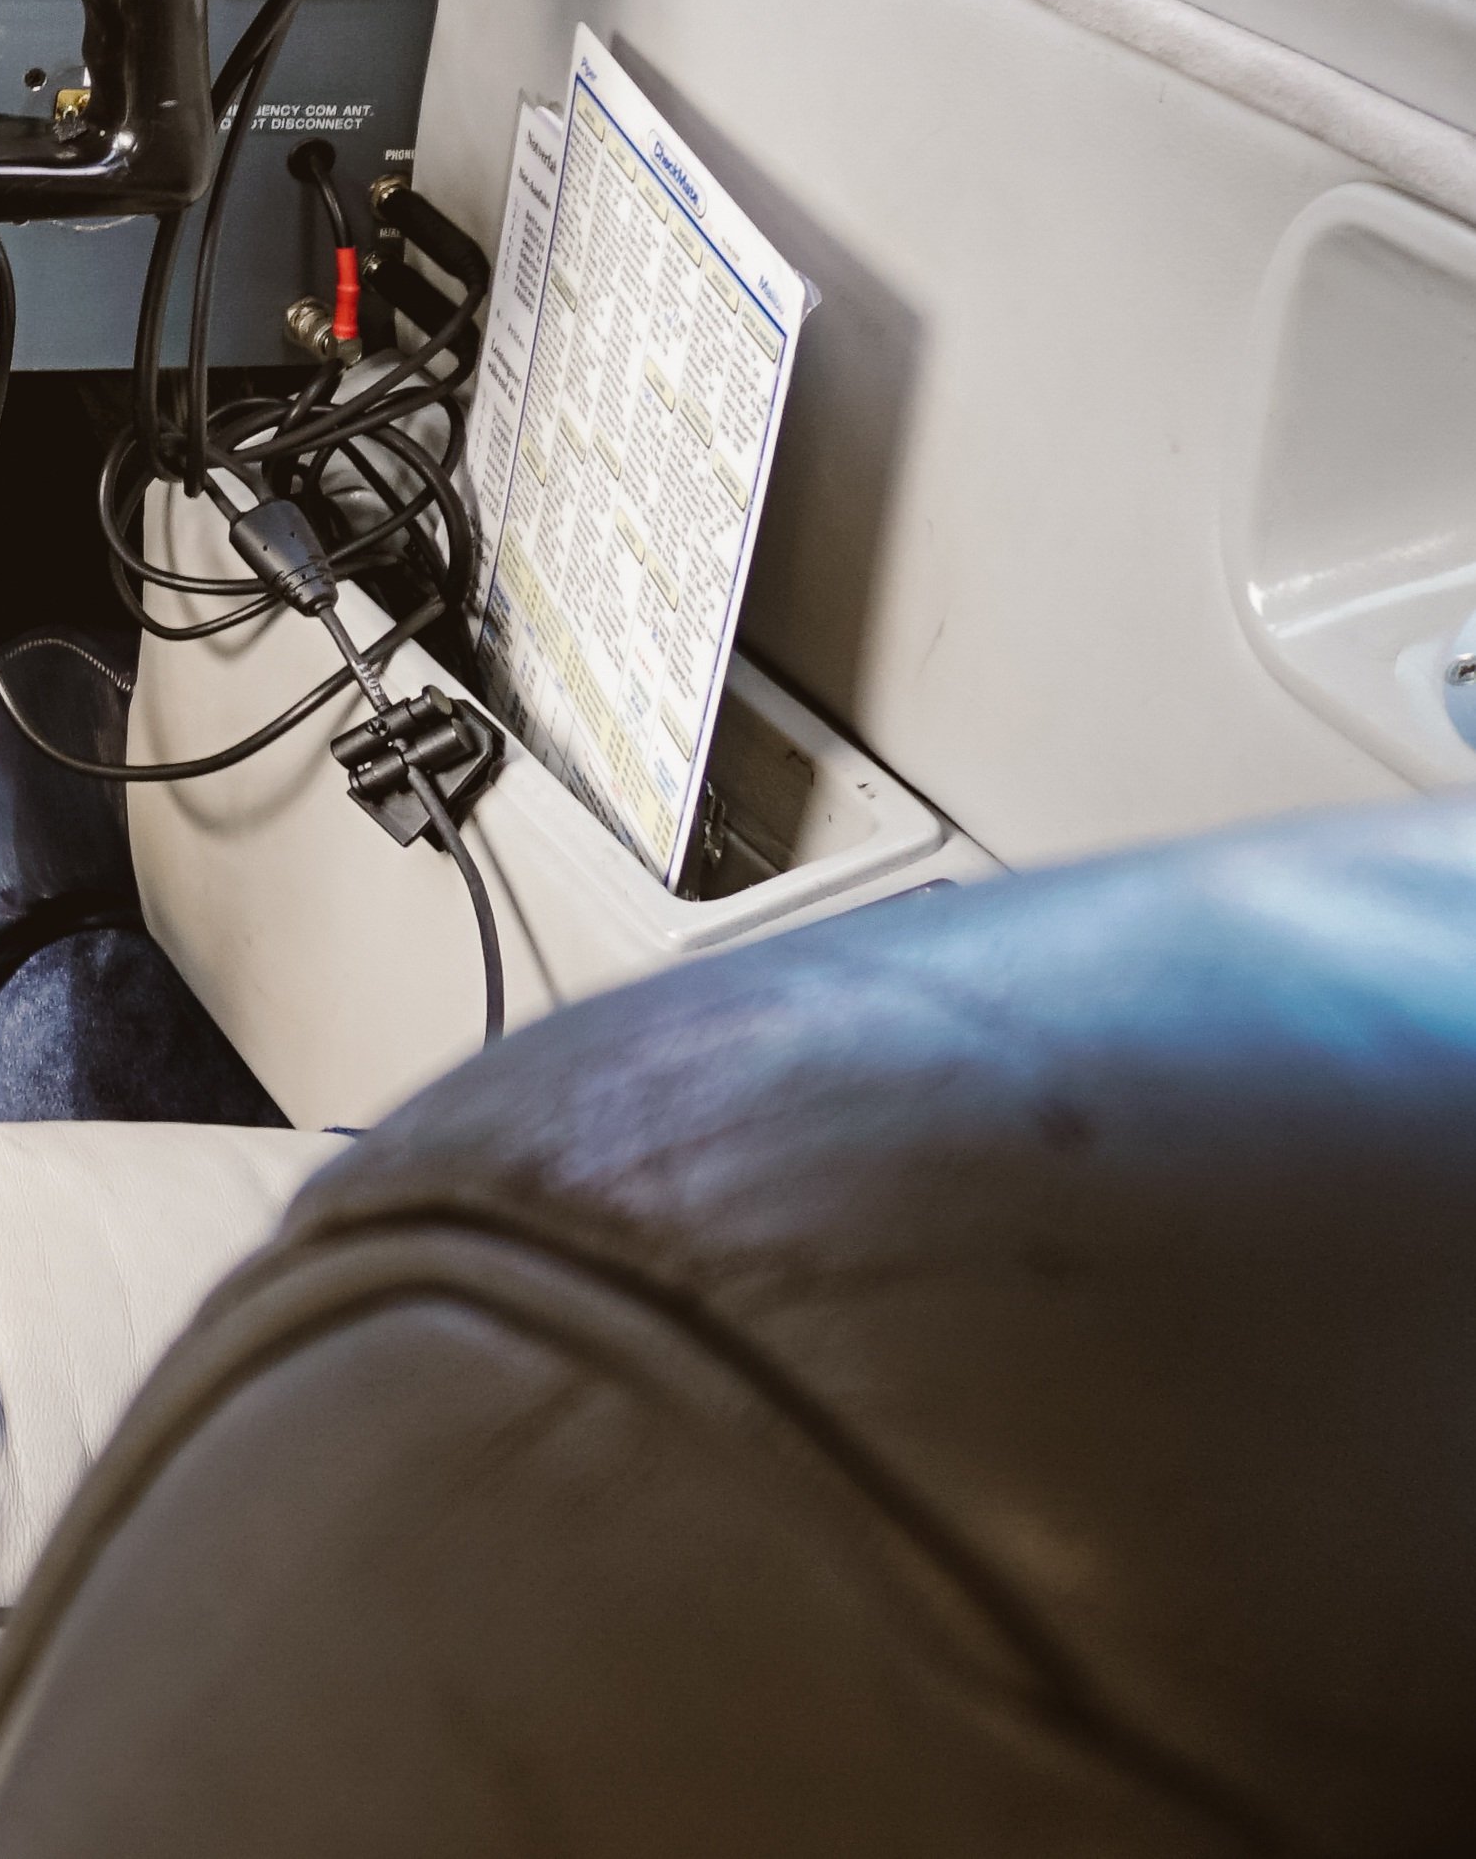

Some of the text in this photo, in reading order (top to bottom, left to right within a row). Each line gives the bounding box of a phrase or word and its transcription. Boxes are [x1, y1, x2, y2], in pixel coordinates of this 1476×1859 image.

[305, 105, 338, 116] COM
[342, 105, 374, 117] ANT.
[271, 118, 363, 130] DISCONNECT
[653, 141, 700, 206] CheckMate
